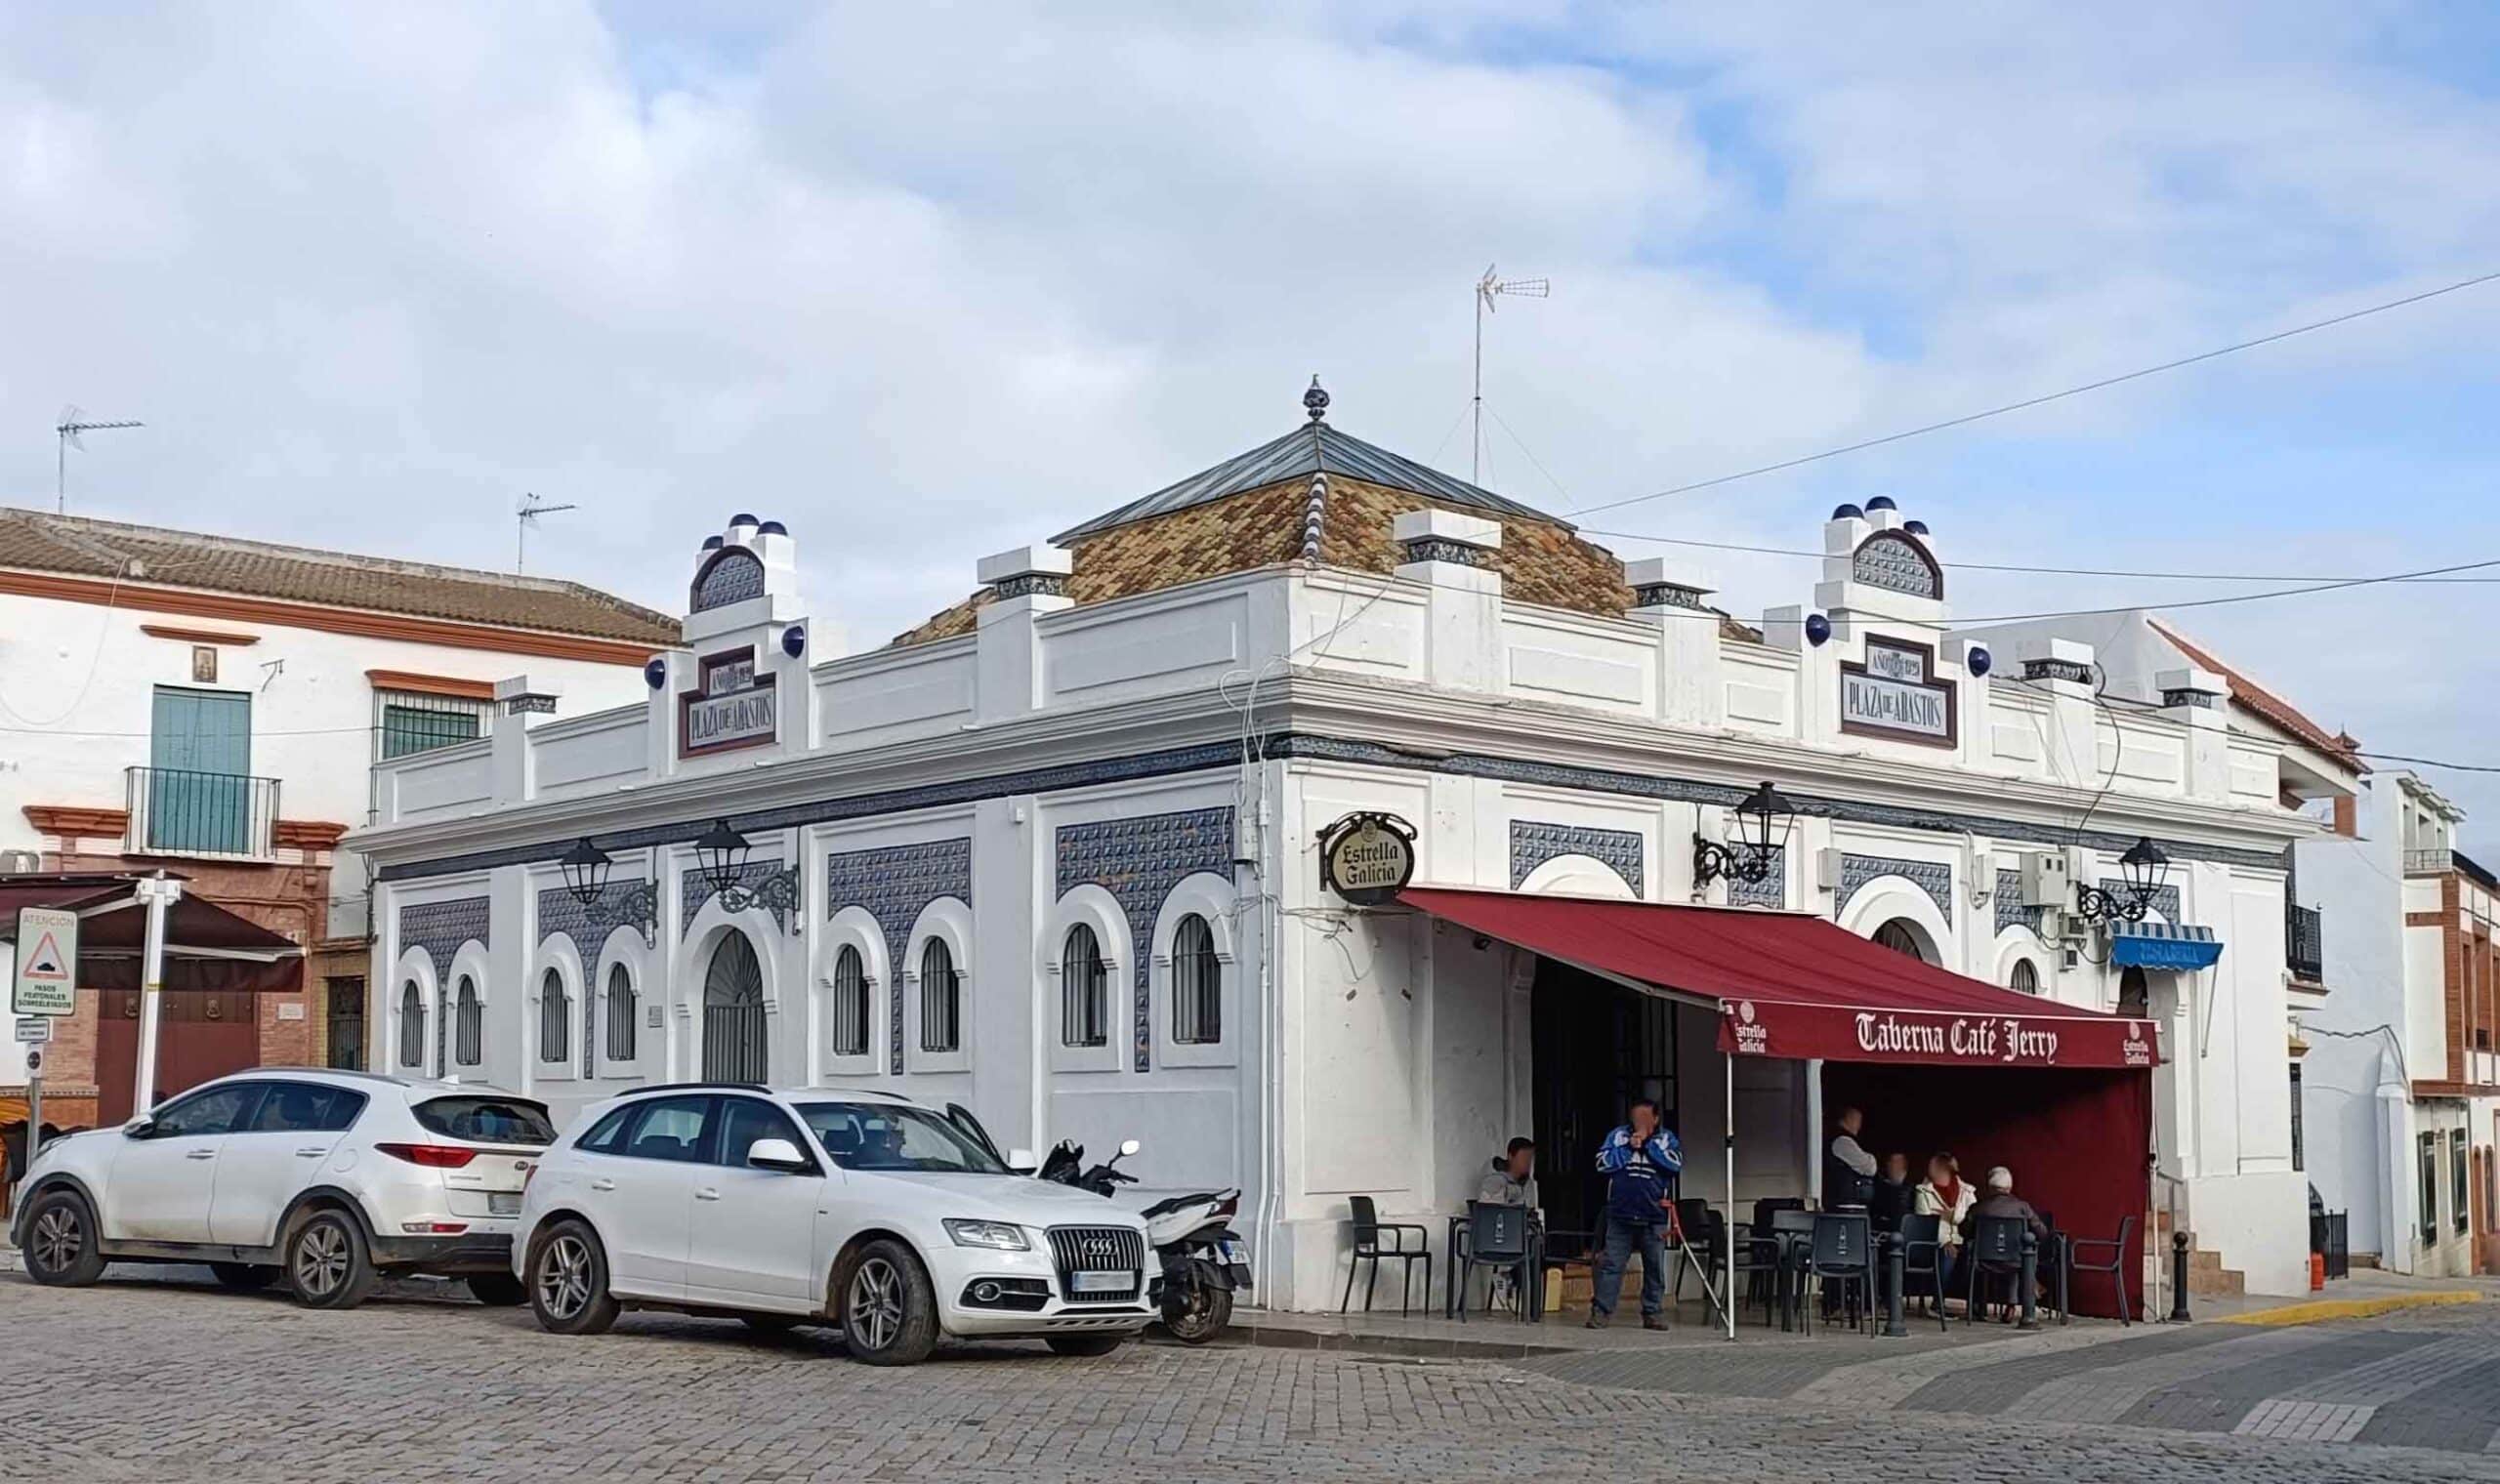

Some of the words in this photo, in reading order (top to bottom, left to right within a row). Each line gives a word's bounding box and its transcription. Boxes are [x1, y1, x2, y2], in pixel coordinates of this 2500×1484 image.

[1849, 681, 1883, 719] PLAZA
[1894, 689, 1941, 728] ABASTOS
[691, 704, 719, 740] PLAZA
[1343, 841, 1398, 864] Estrella
[1346, 861, 1396, 885] Galicia
[23, 992, 66, 1001] PEATONALES
[34, 984, 57, 993] PASOS
[1855, 1012, 1944, 1053] Taberna
[1950, 1017, 1997, 1055] Café
[2003, 1020, 2058, 1064] Jerry
